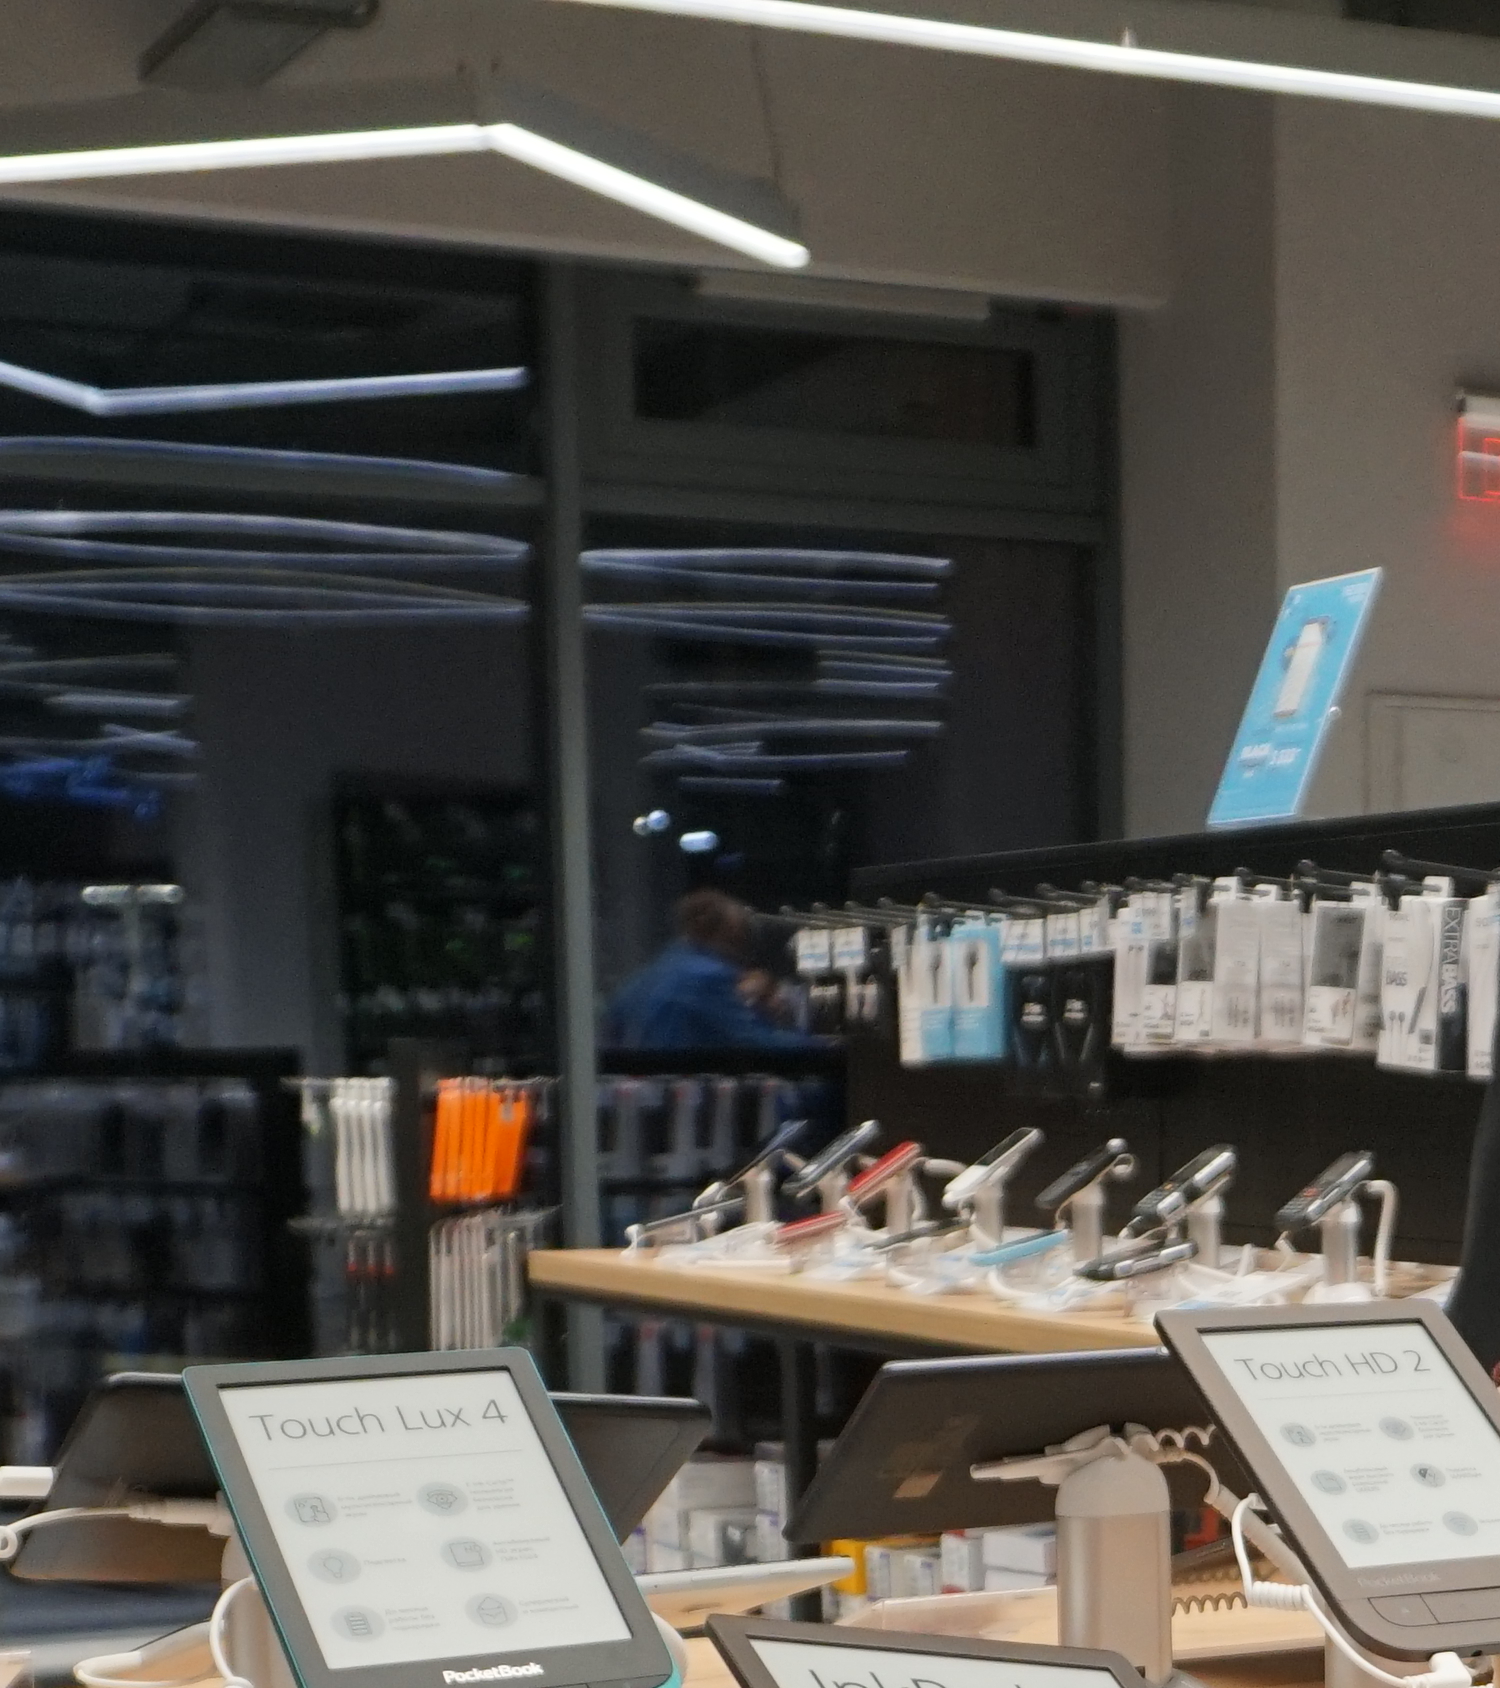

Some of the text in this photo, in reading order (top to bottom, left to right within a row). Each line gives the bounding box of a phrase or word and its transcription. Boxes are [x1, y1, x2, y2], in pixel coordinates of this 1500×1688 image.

[1234, 1347, 1431, 1383] Touch HD 2
[249, 1399, 508, 1442] Touch Lux 4
[443, 1662, 544, 1684] PocketBook
